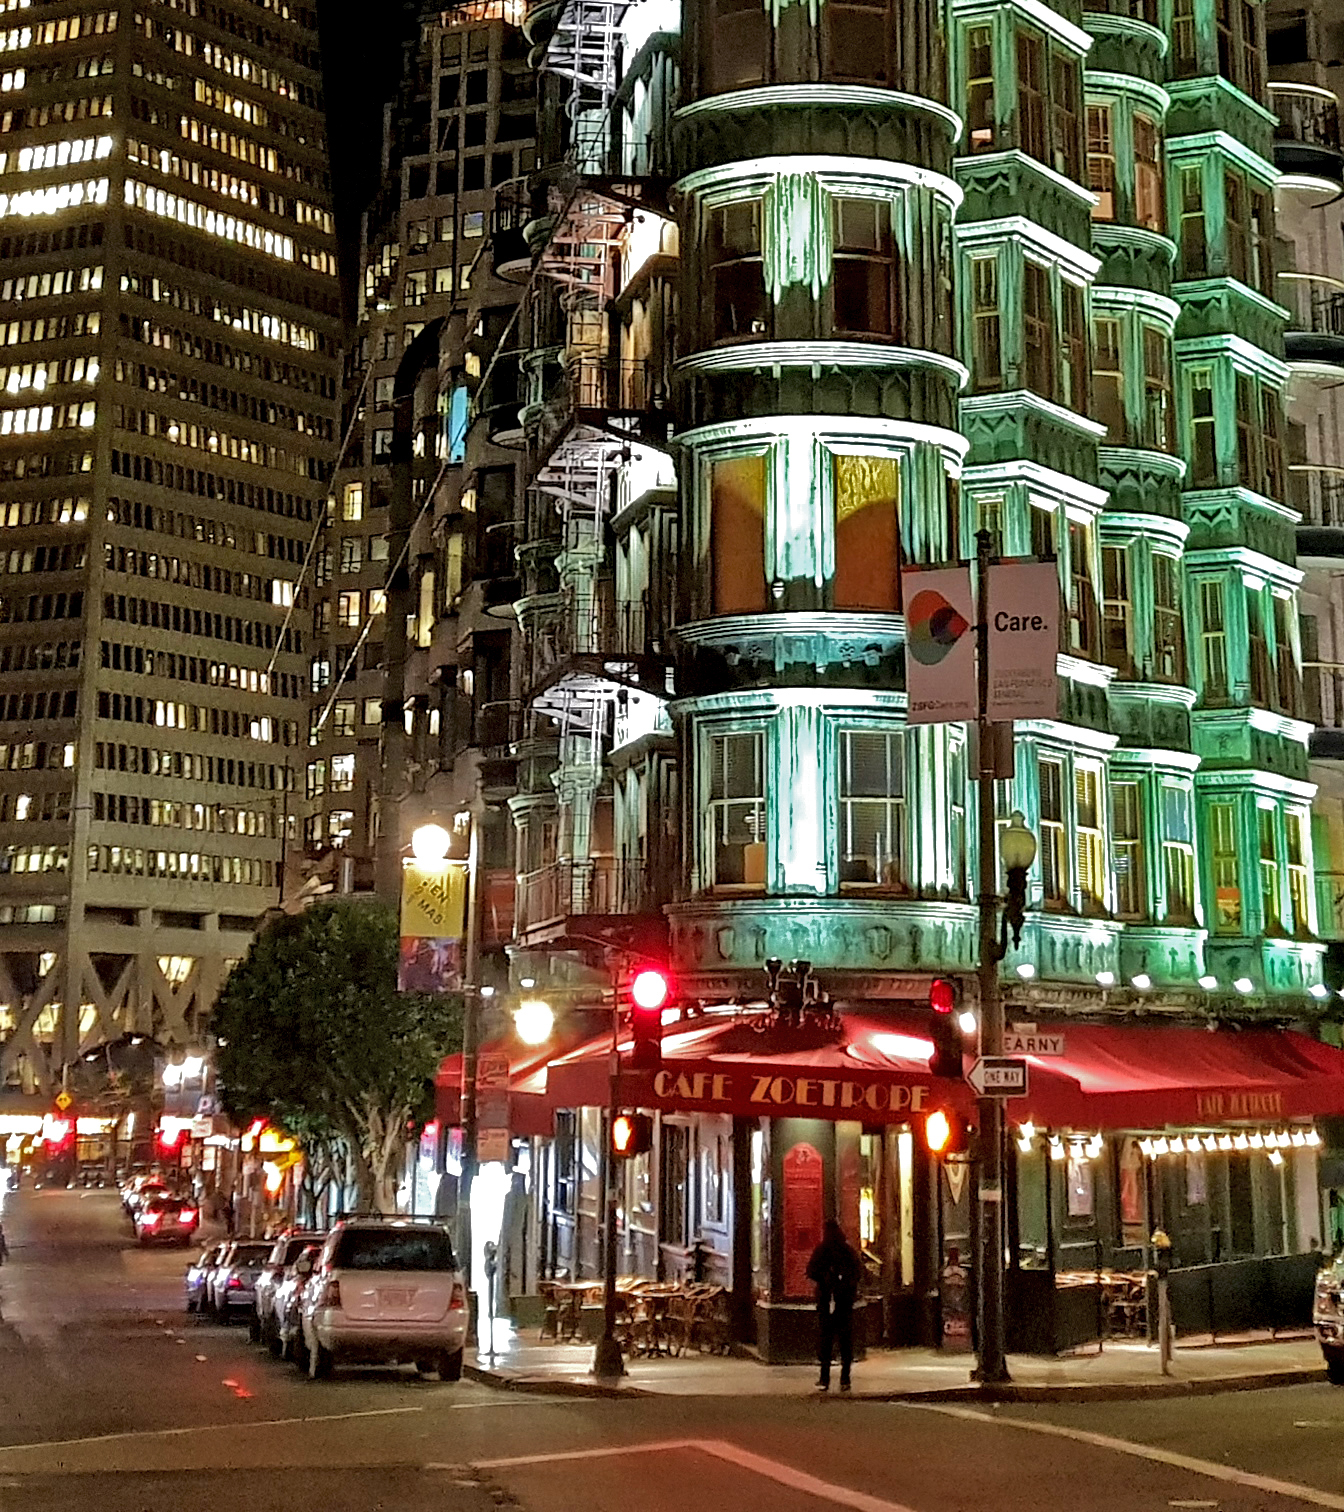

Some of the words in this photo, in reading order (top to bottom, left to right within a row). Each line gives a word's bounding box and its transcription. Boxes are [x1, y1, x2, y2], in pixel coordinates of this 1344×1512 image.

[994, 611, 1048, 632] Care.
[1003, 1037, 1060, 1052] EARNY
[984, 1071, 1001, 1083] ONE
[1004, 1071, 1020, 1083] WAY
[653, 1069, 734, 1101] CAFE
[749, 1076, 931, 1113] ZOETROPE
